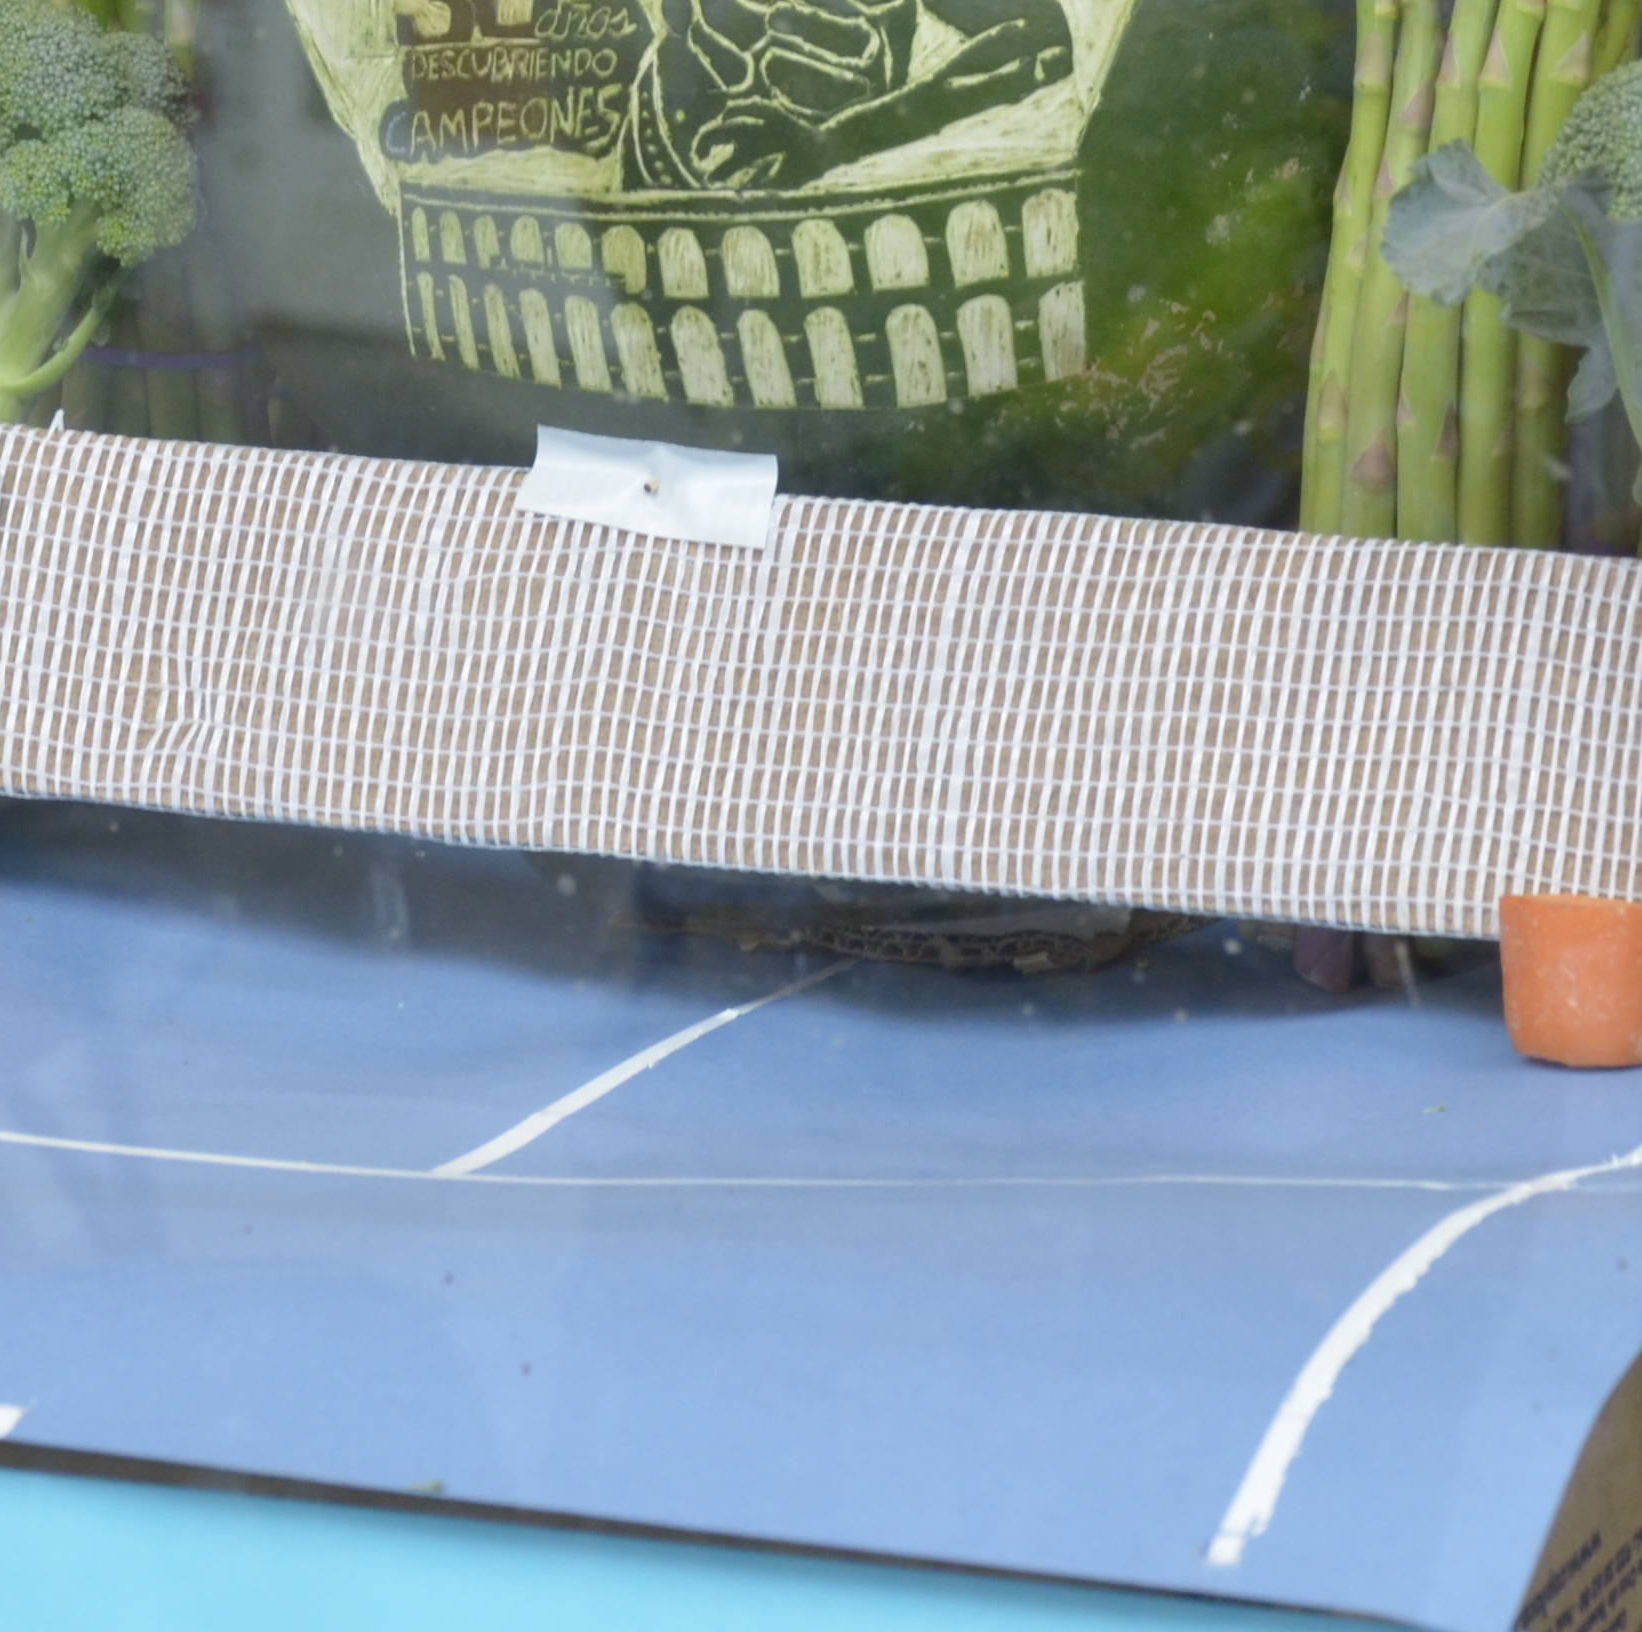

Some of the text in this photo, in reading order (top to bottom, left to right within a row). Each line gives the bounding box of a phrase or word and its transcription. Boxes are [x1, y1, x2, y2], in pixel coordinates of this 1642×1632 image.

[535, 3, 638, 40] años
[410, 47, 618, 85] DESCUBRIENDO
[384, 84, 623, 156] CAMPEONES
